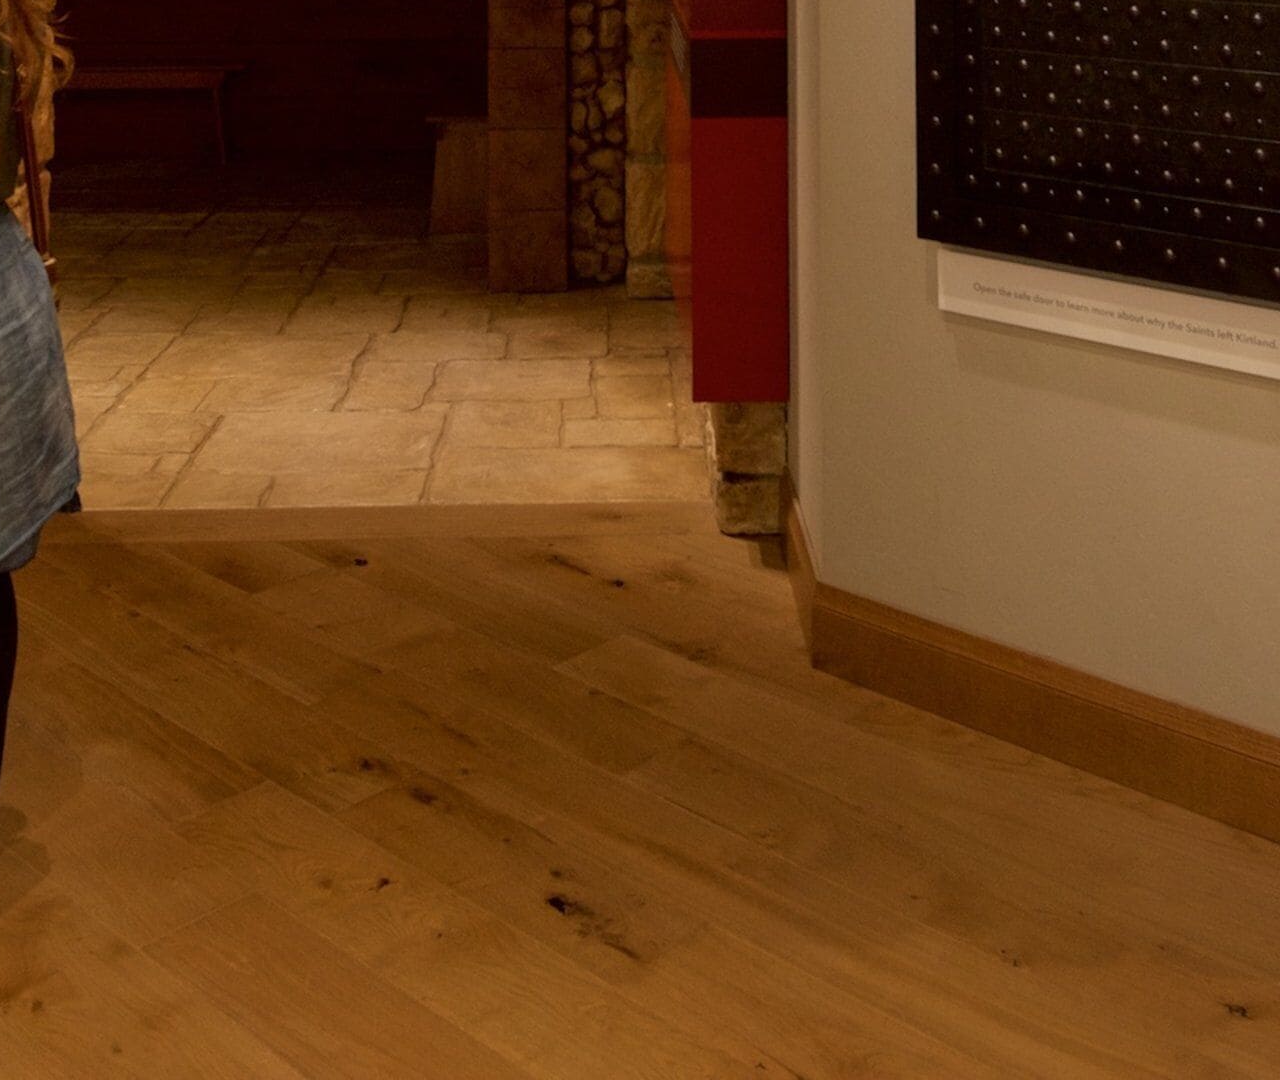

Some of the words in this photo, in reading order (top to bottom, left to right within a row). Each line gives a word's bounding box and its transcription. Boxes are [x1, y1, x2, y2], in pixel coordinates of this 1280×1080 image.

[973, 282, 997, 295] Open
[998, 286, 1012, 297] the
[1033, 294, 1054, 306] door
[1055, 299, 1065, 308] to
[1067, 301, 1090, 313] learn
[1091, 307, 1115, 318] more
[1117, 310, 1145, 325] about
[1146, 317, 1165, 330] why
[1168, 321, 1183, 331] the
[1186, 323, 1215, 338] Saints
[1217, 329, 1234, 342] left
